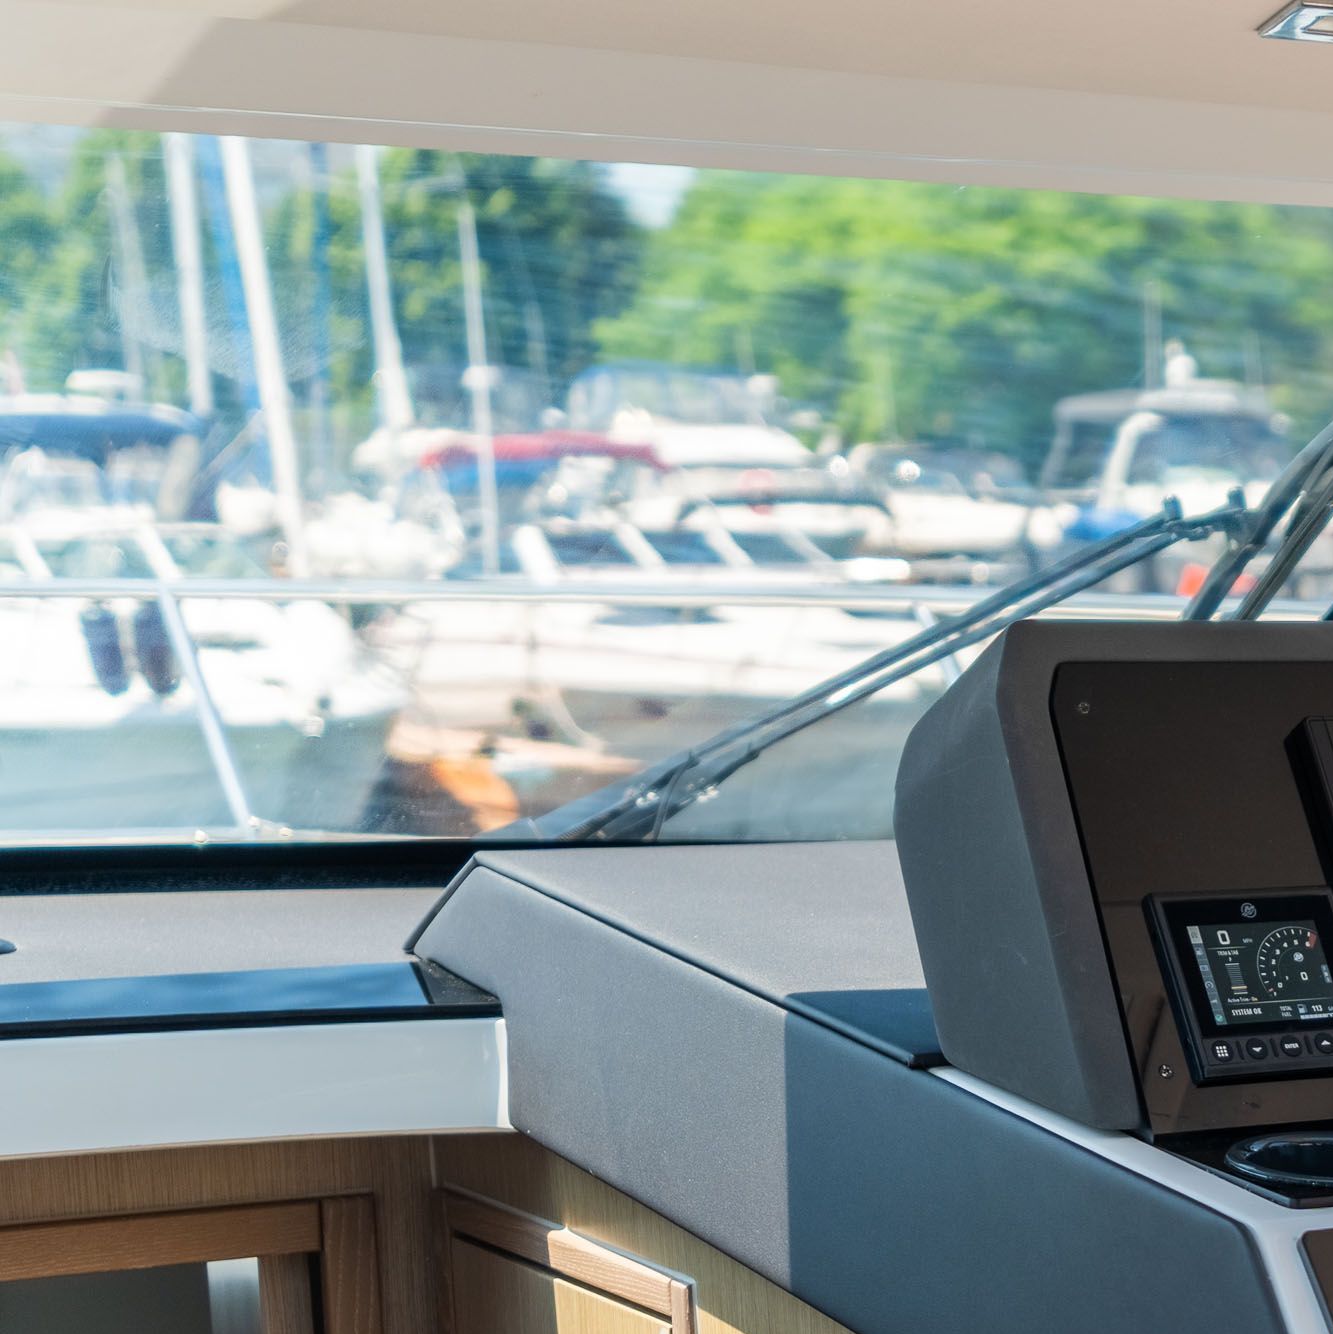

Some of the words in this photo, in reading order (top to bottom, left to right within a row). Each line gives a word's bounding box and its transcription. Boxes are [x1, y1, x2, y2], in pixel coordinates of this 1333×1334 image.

[1216, 929, 1231, 945] 0
[1300, 971, 1309, 981] 0
[1232, 1008, 1253, 1016] SYSTEM
[1253, 1007, 1262, 1015] OK
